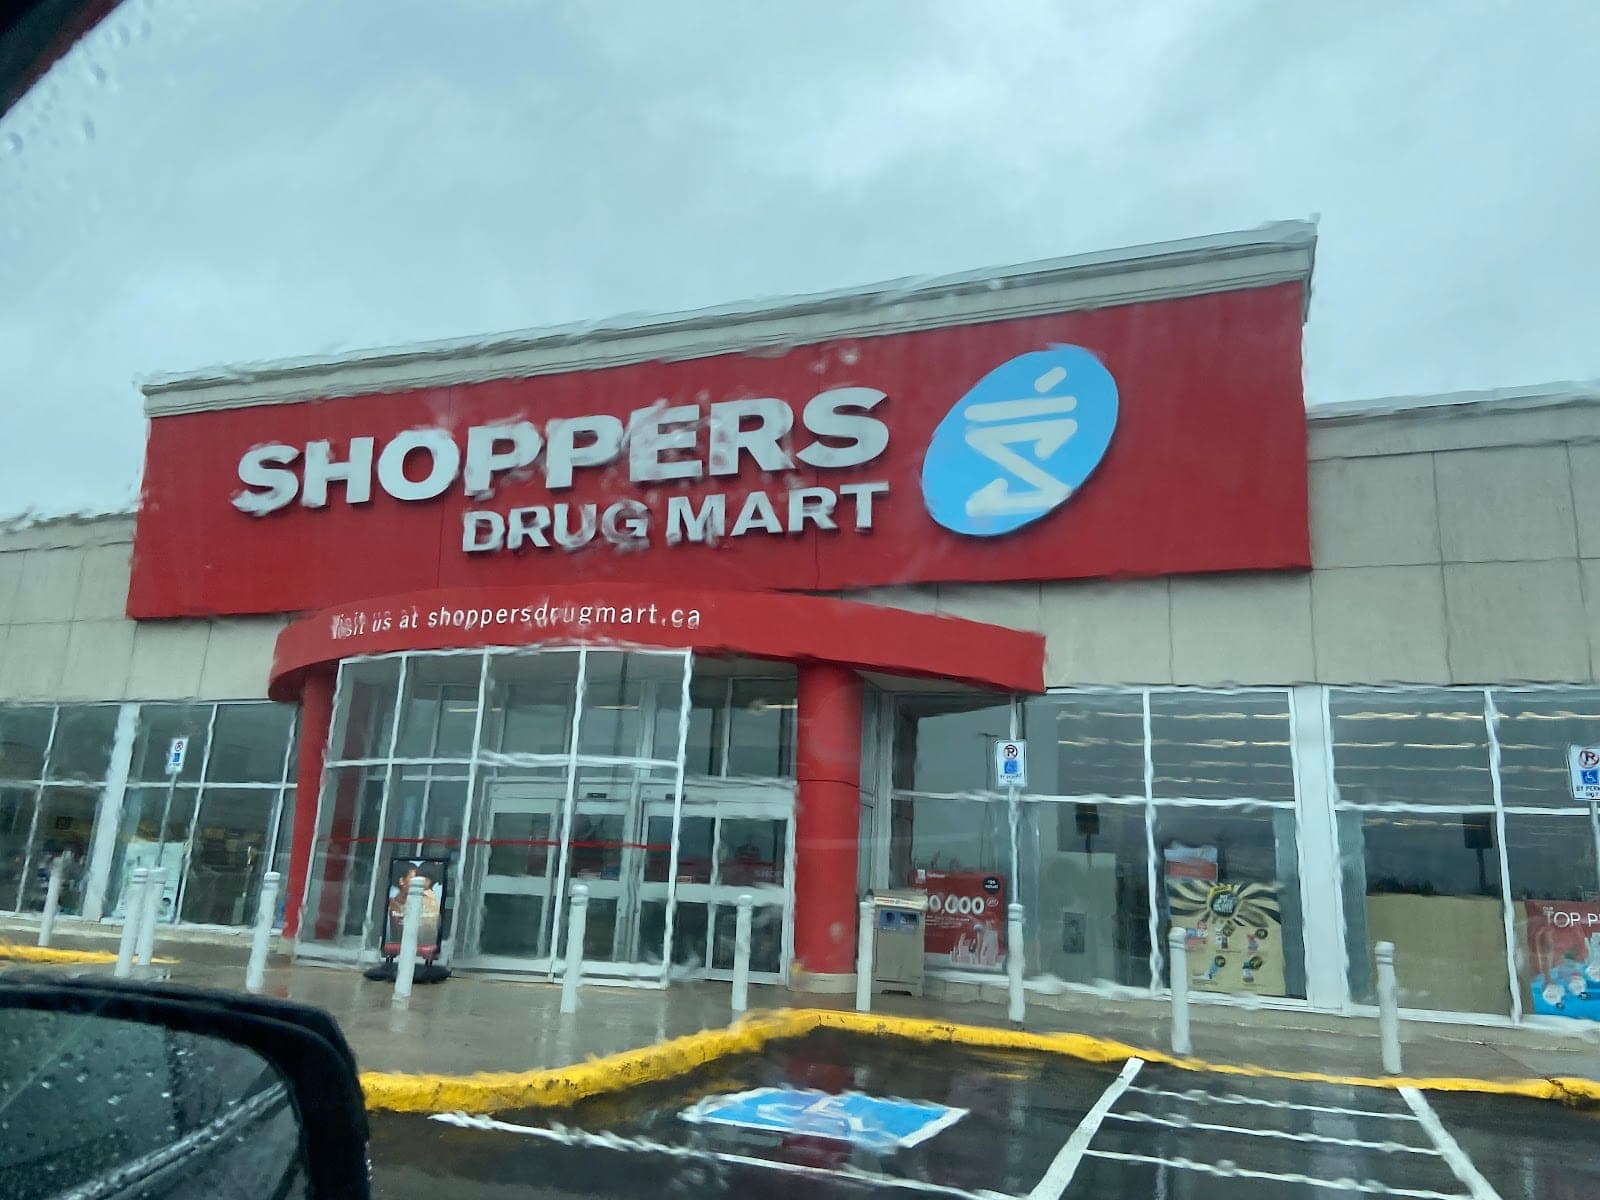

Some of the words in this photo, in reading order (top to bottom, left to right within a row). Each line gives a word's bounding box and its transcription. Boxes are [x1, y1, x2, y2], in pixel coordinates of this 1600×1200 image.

[231, 387, 889, 516] SHOPPERS
[462, 500, 649, 552] DRUG
[666, 482, 889, 542] MART
[372, 611, 392, 632] us
[399, 606, 418, 628] at
[427, 600, 700, 630] shoppersdrugmart.ca
[928, 894, 984, 915] 0,000
[1543, 906, 1580, 928] TOP
[1587, 912, 1600, 928] P
